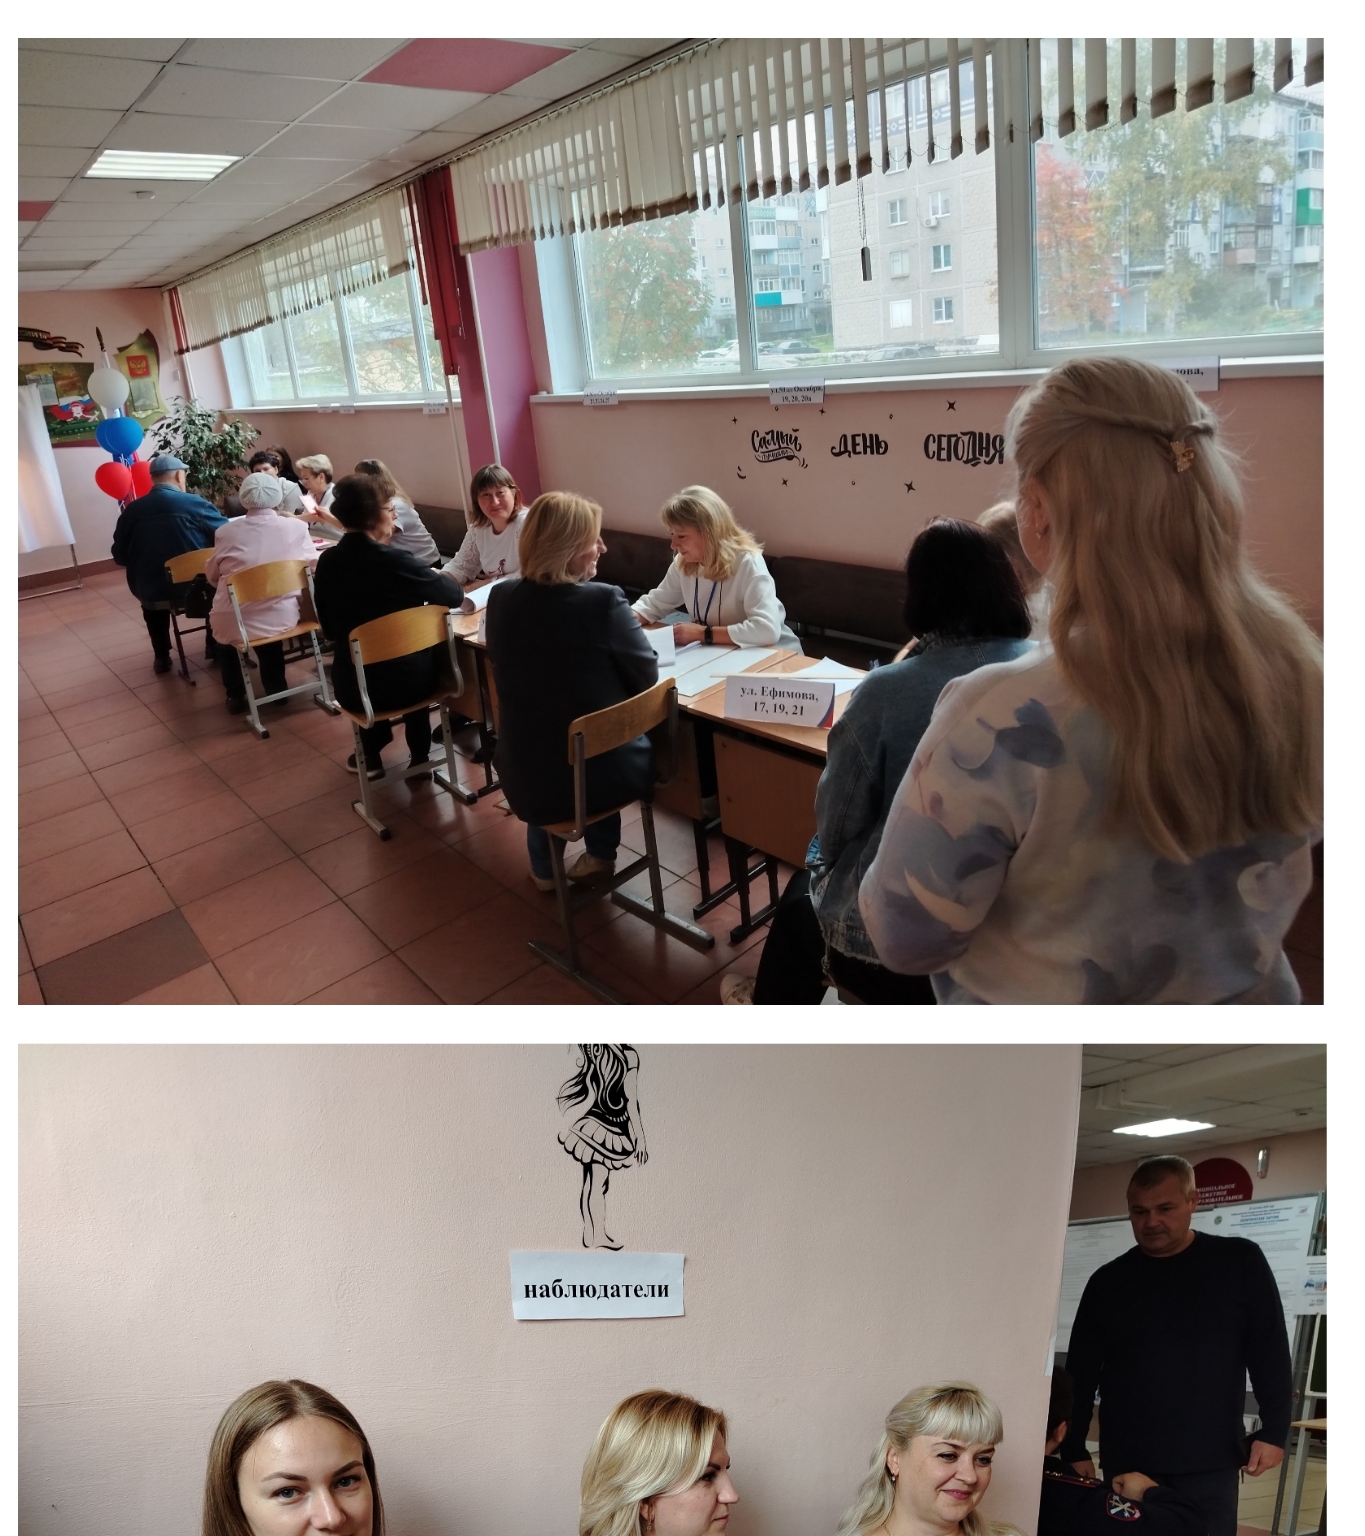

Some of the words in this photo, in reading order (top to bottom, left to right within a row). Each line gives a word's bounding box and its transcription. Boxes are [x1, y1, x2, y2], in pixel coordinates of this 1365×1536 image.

[830, 433, 889, 458] ДЕНЬ
[923, 431, 1005, 467] СЕГОДНЯ
[740, 687, 756, 698] ул.
[761, 685, 819, 703] Ефимова,
[753, 701, 769, 715] 17,
[772, 702, 789, 716] 19,
[791, 704, 805, 716] 21
[523, 1278, 670, 1300] наблюдатели
